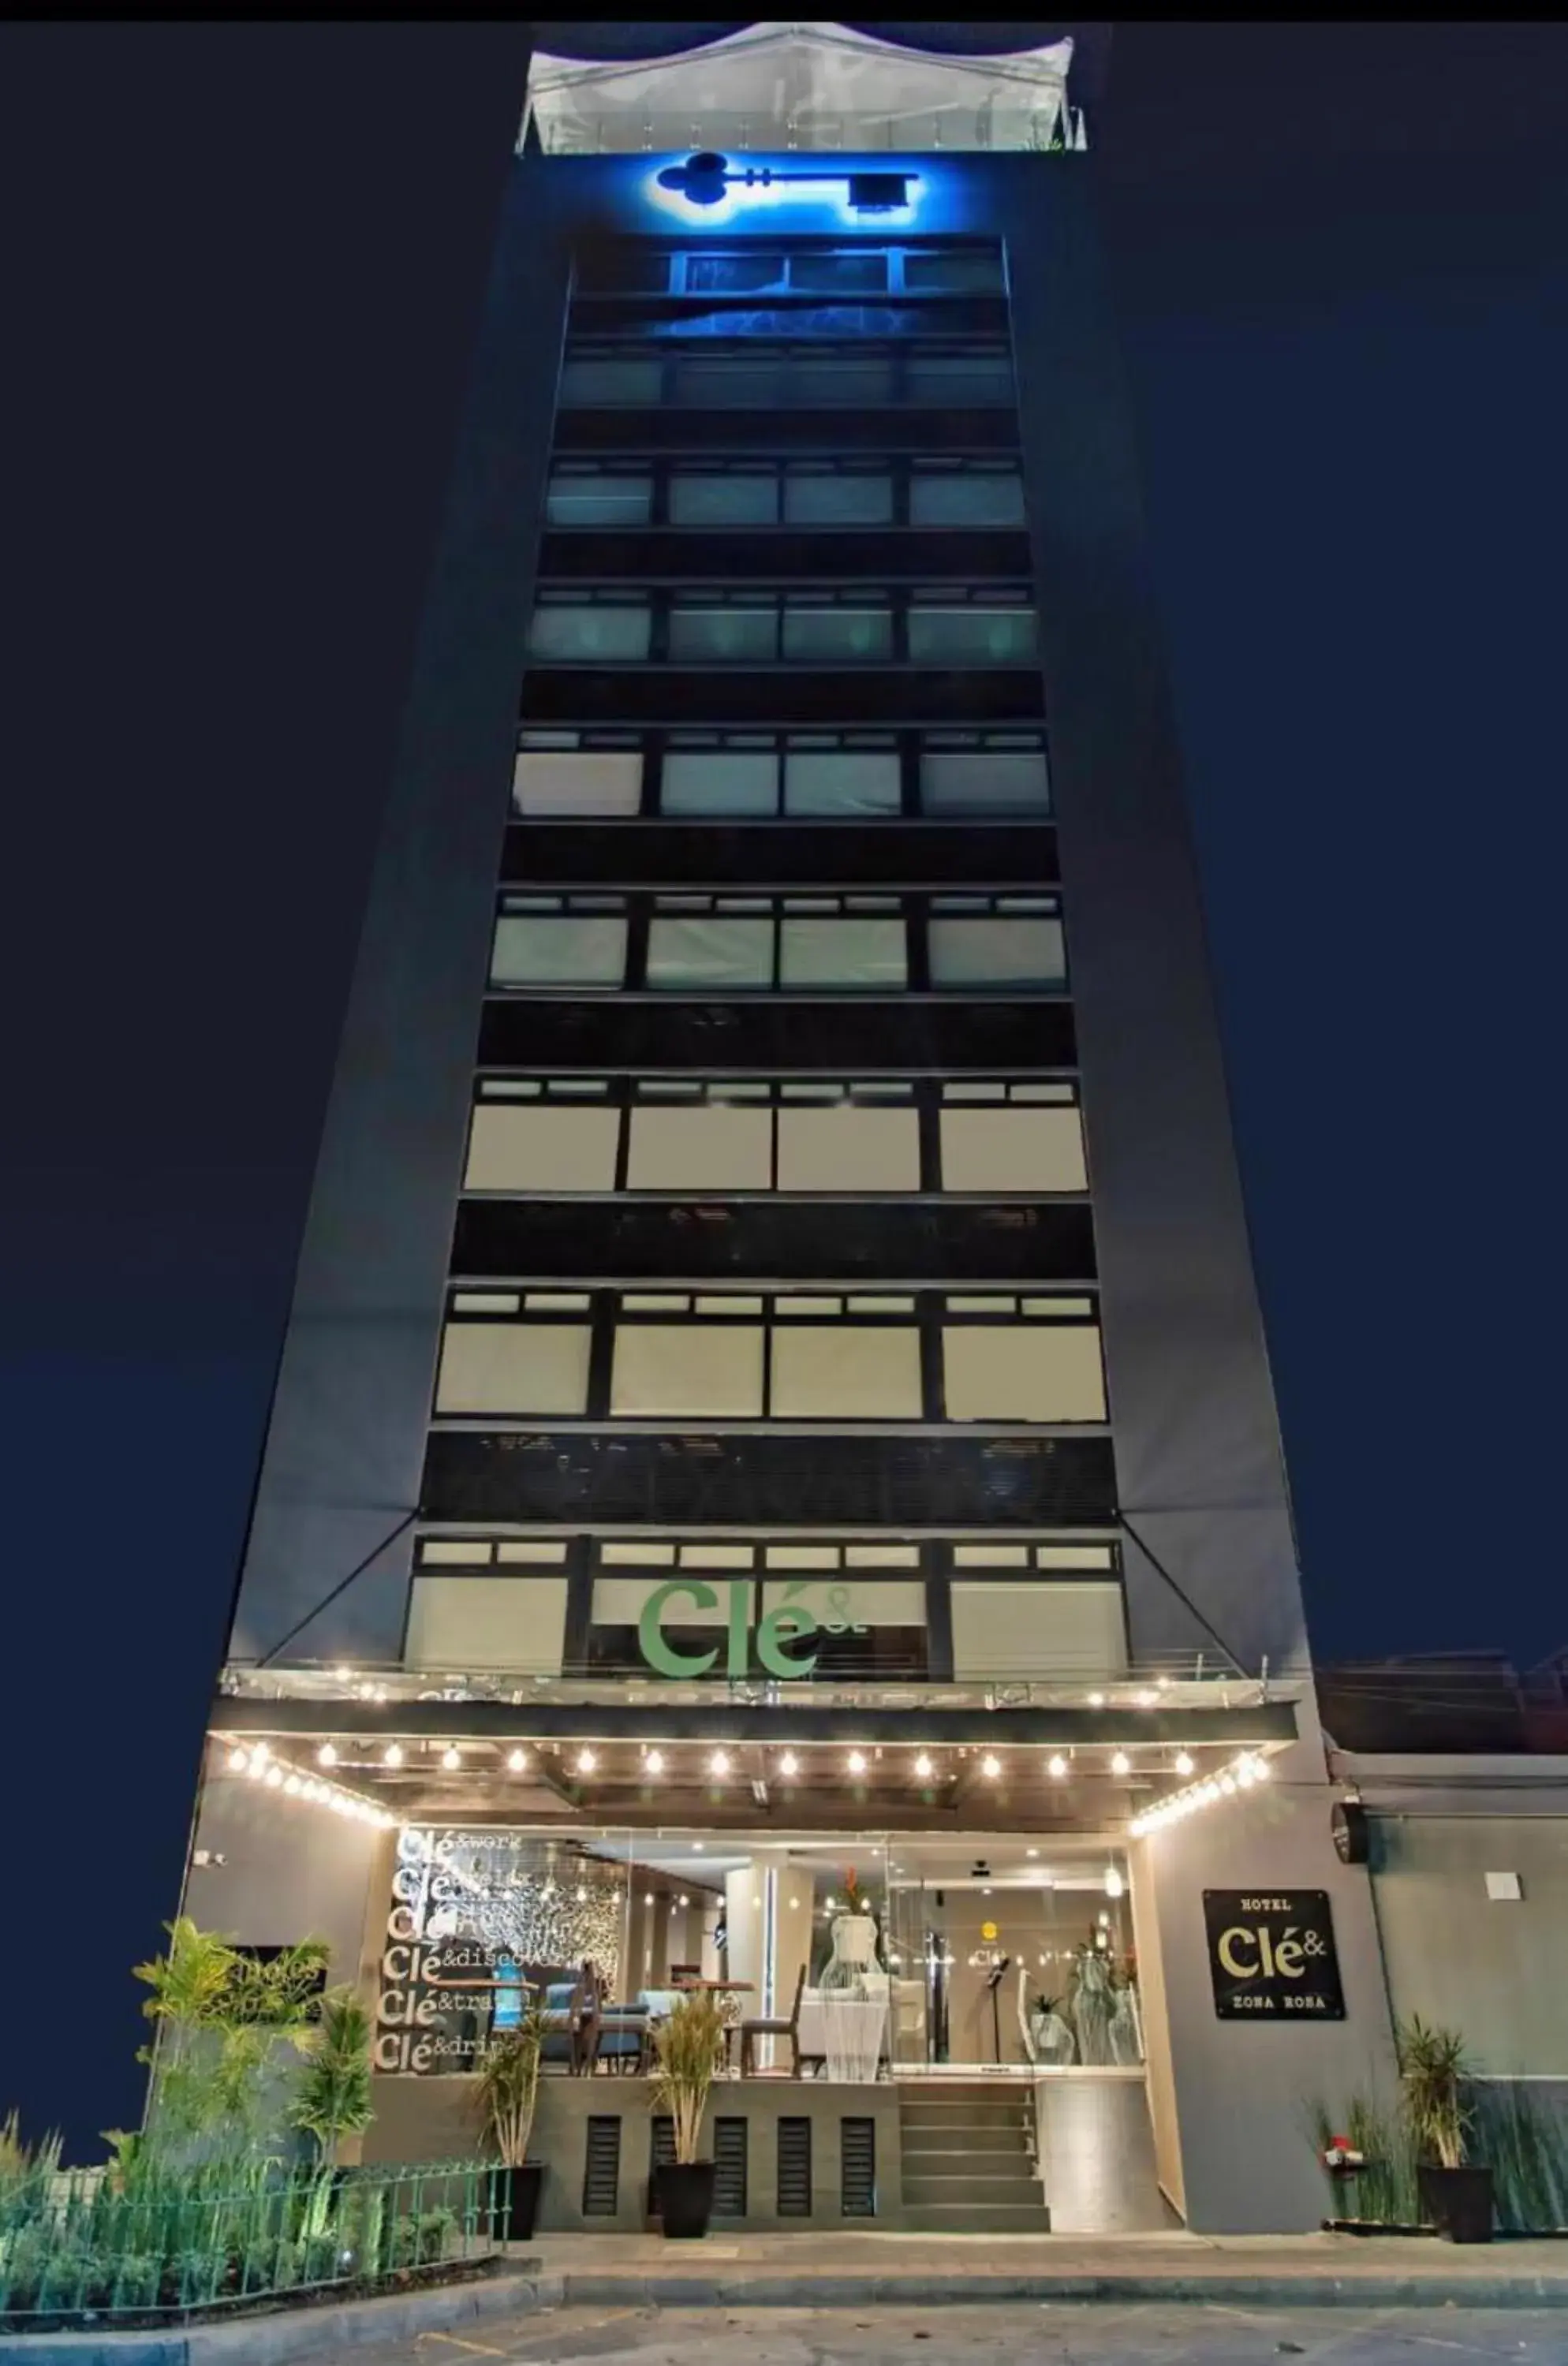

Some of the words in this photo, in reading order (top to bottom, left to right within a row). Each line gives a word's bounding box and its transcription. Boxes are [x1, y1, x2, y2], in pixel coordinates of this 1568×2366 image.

[1241, 1898, 1292, 1912] HOTEL
[1233, 1996, 1275, 2009] ZONA
[1283, 1996, 1327, 2009] ROSA
